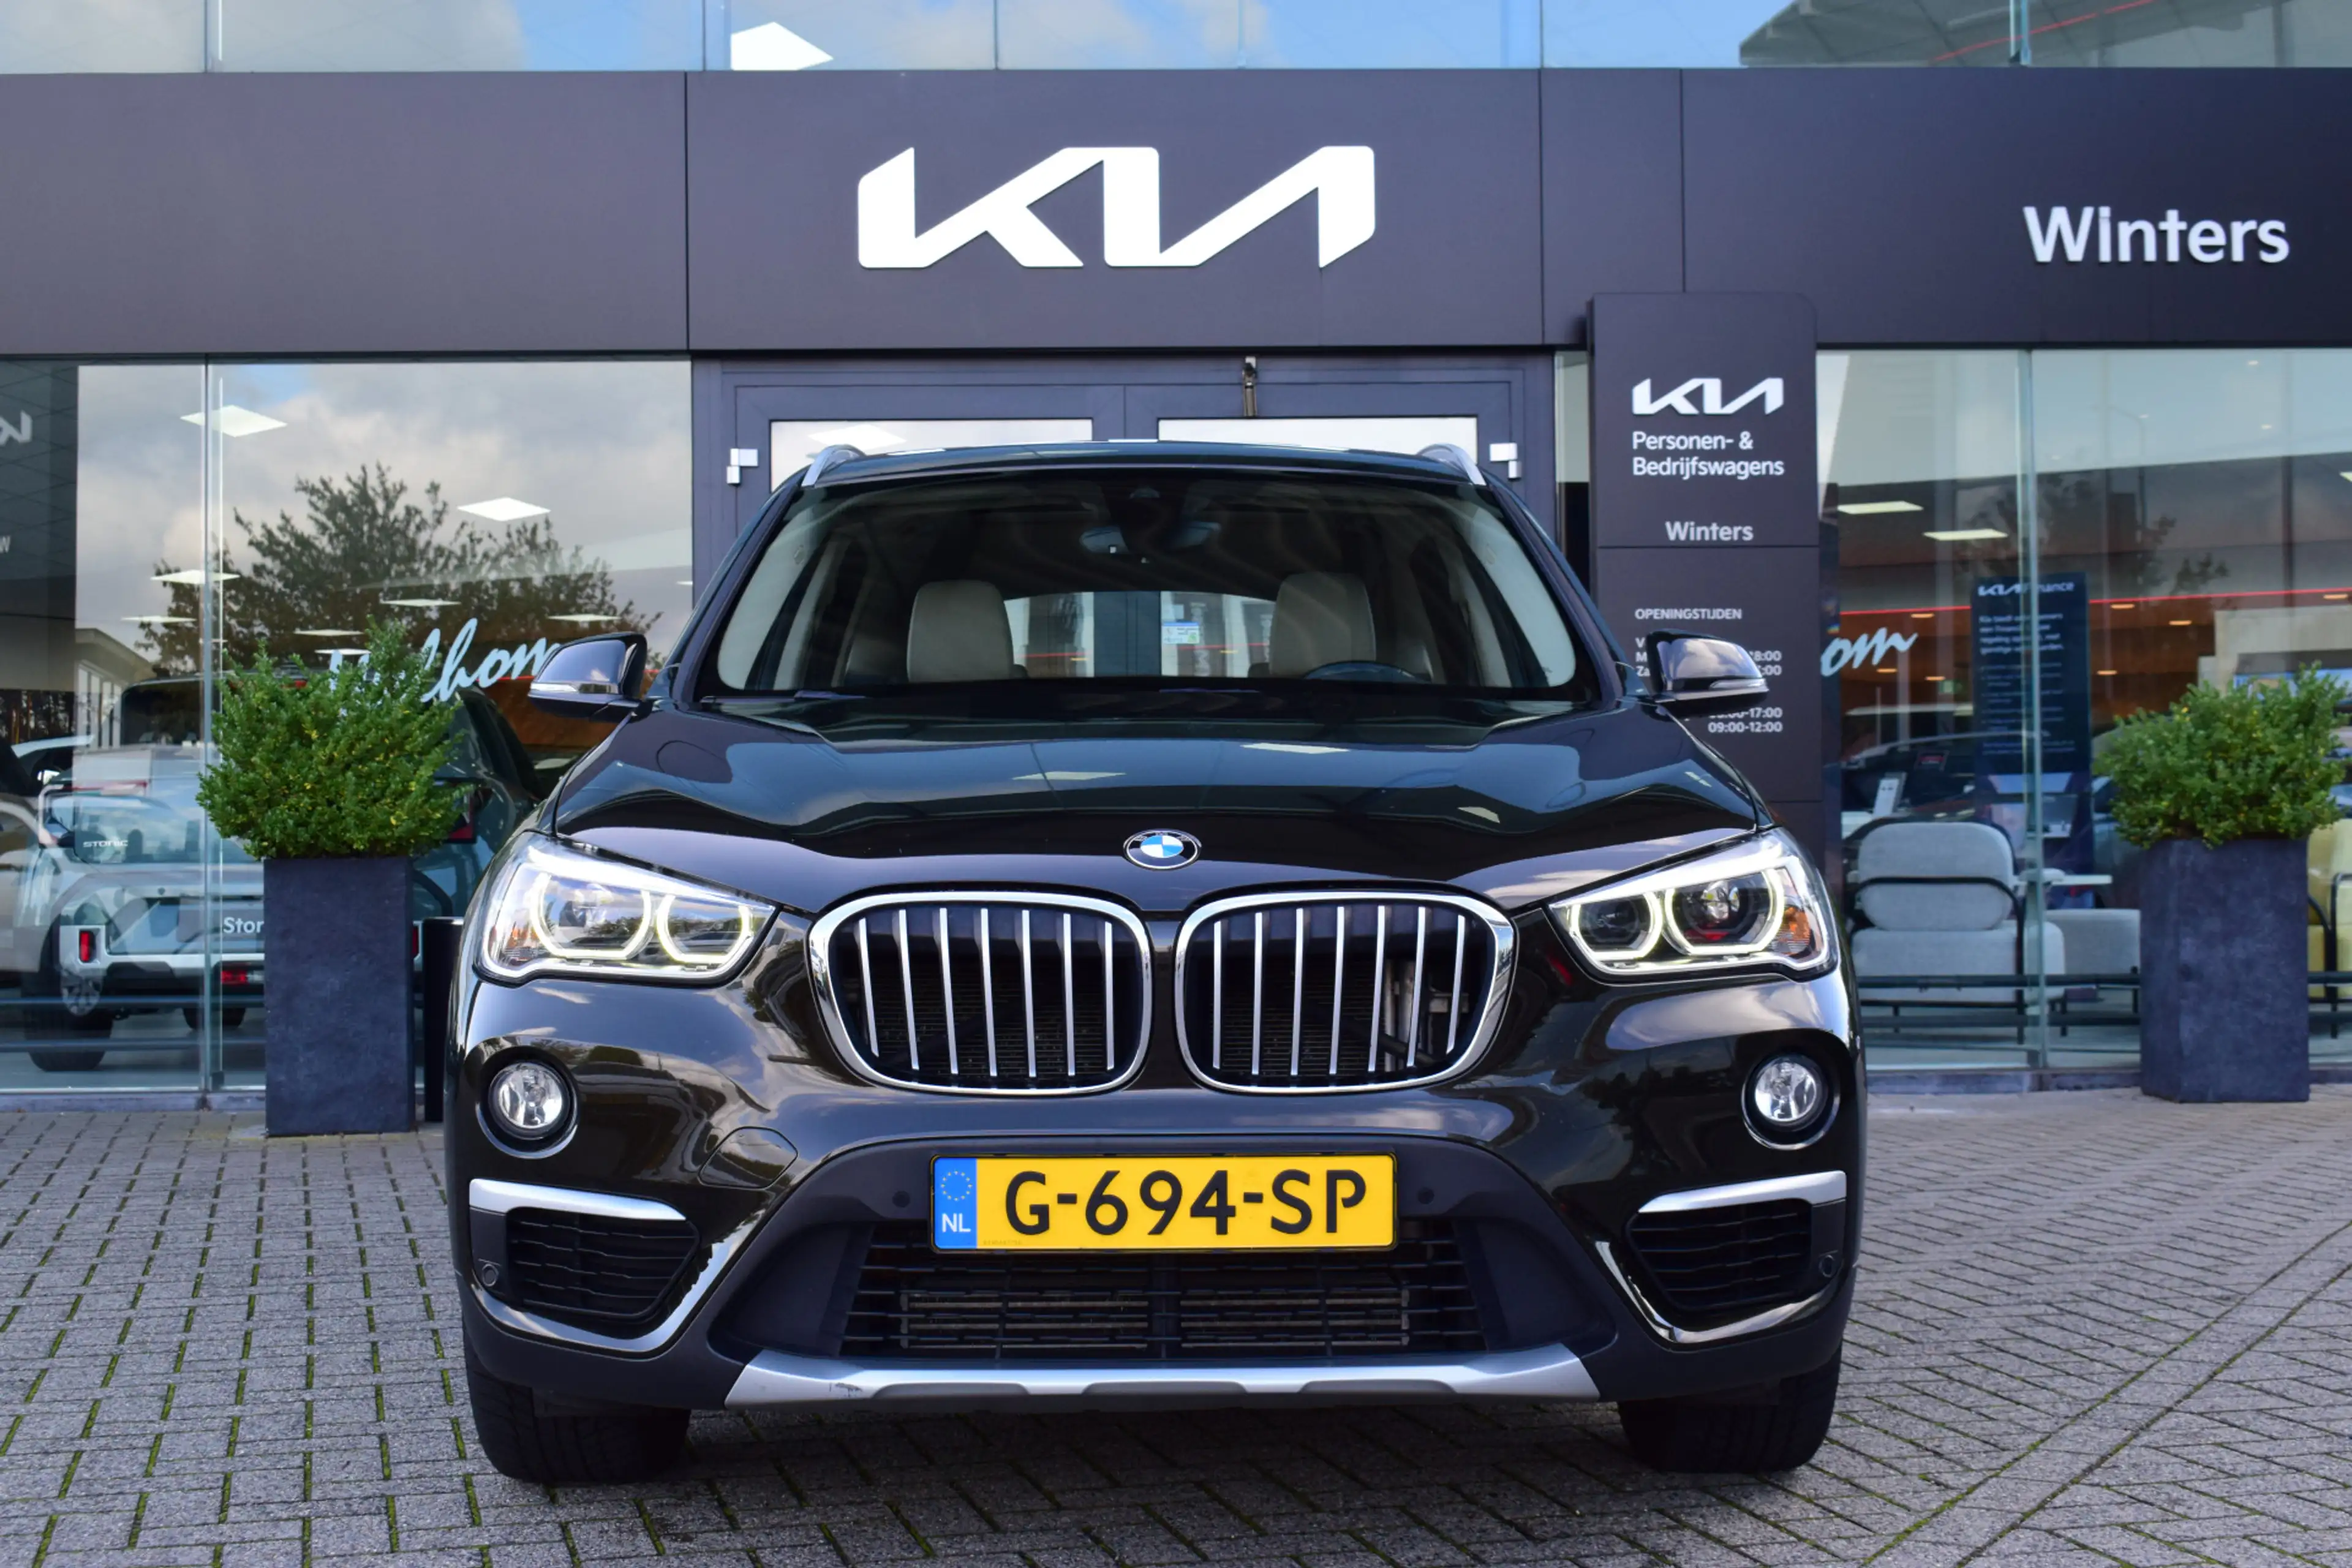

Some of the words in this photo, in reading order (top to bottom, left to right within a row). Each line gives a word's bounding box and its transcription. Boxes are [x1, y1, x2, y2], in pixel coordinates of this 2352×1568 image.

[858, 146, 1375, 268] KIA
[2022, 206, 2290, 263] Winters
[1632, 377, 1784, 415] KIA
[1632, 431, 1734, 450] Personen-
[1738, 431, 1754, 450] &
[1632, 456, 1785, 480] Bedrijfswagens
[1665, 521, 1754, 541] Winters
[1634, 608, 1743, 620] OPENINGSTIJDEN
[1708, 722, 1783, 733] 09:00-12:00
[941, 1213, 971, 1232] NL
[1005, 1169, 1366, 1235] G-694-SP
